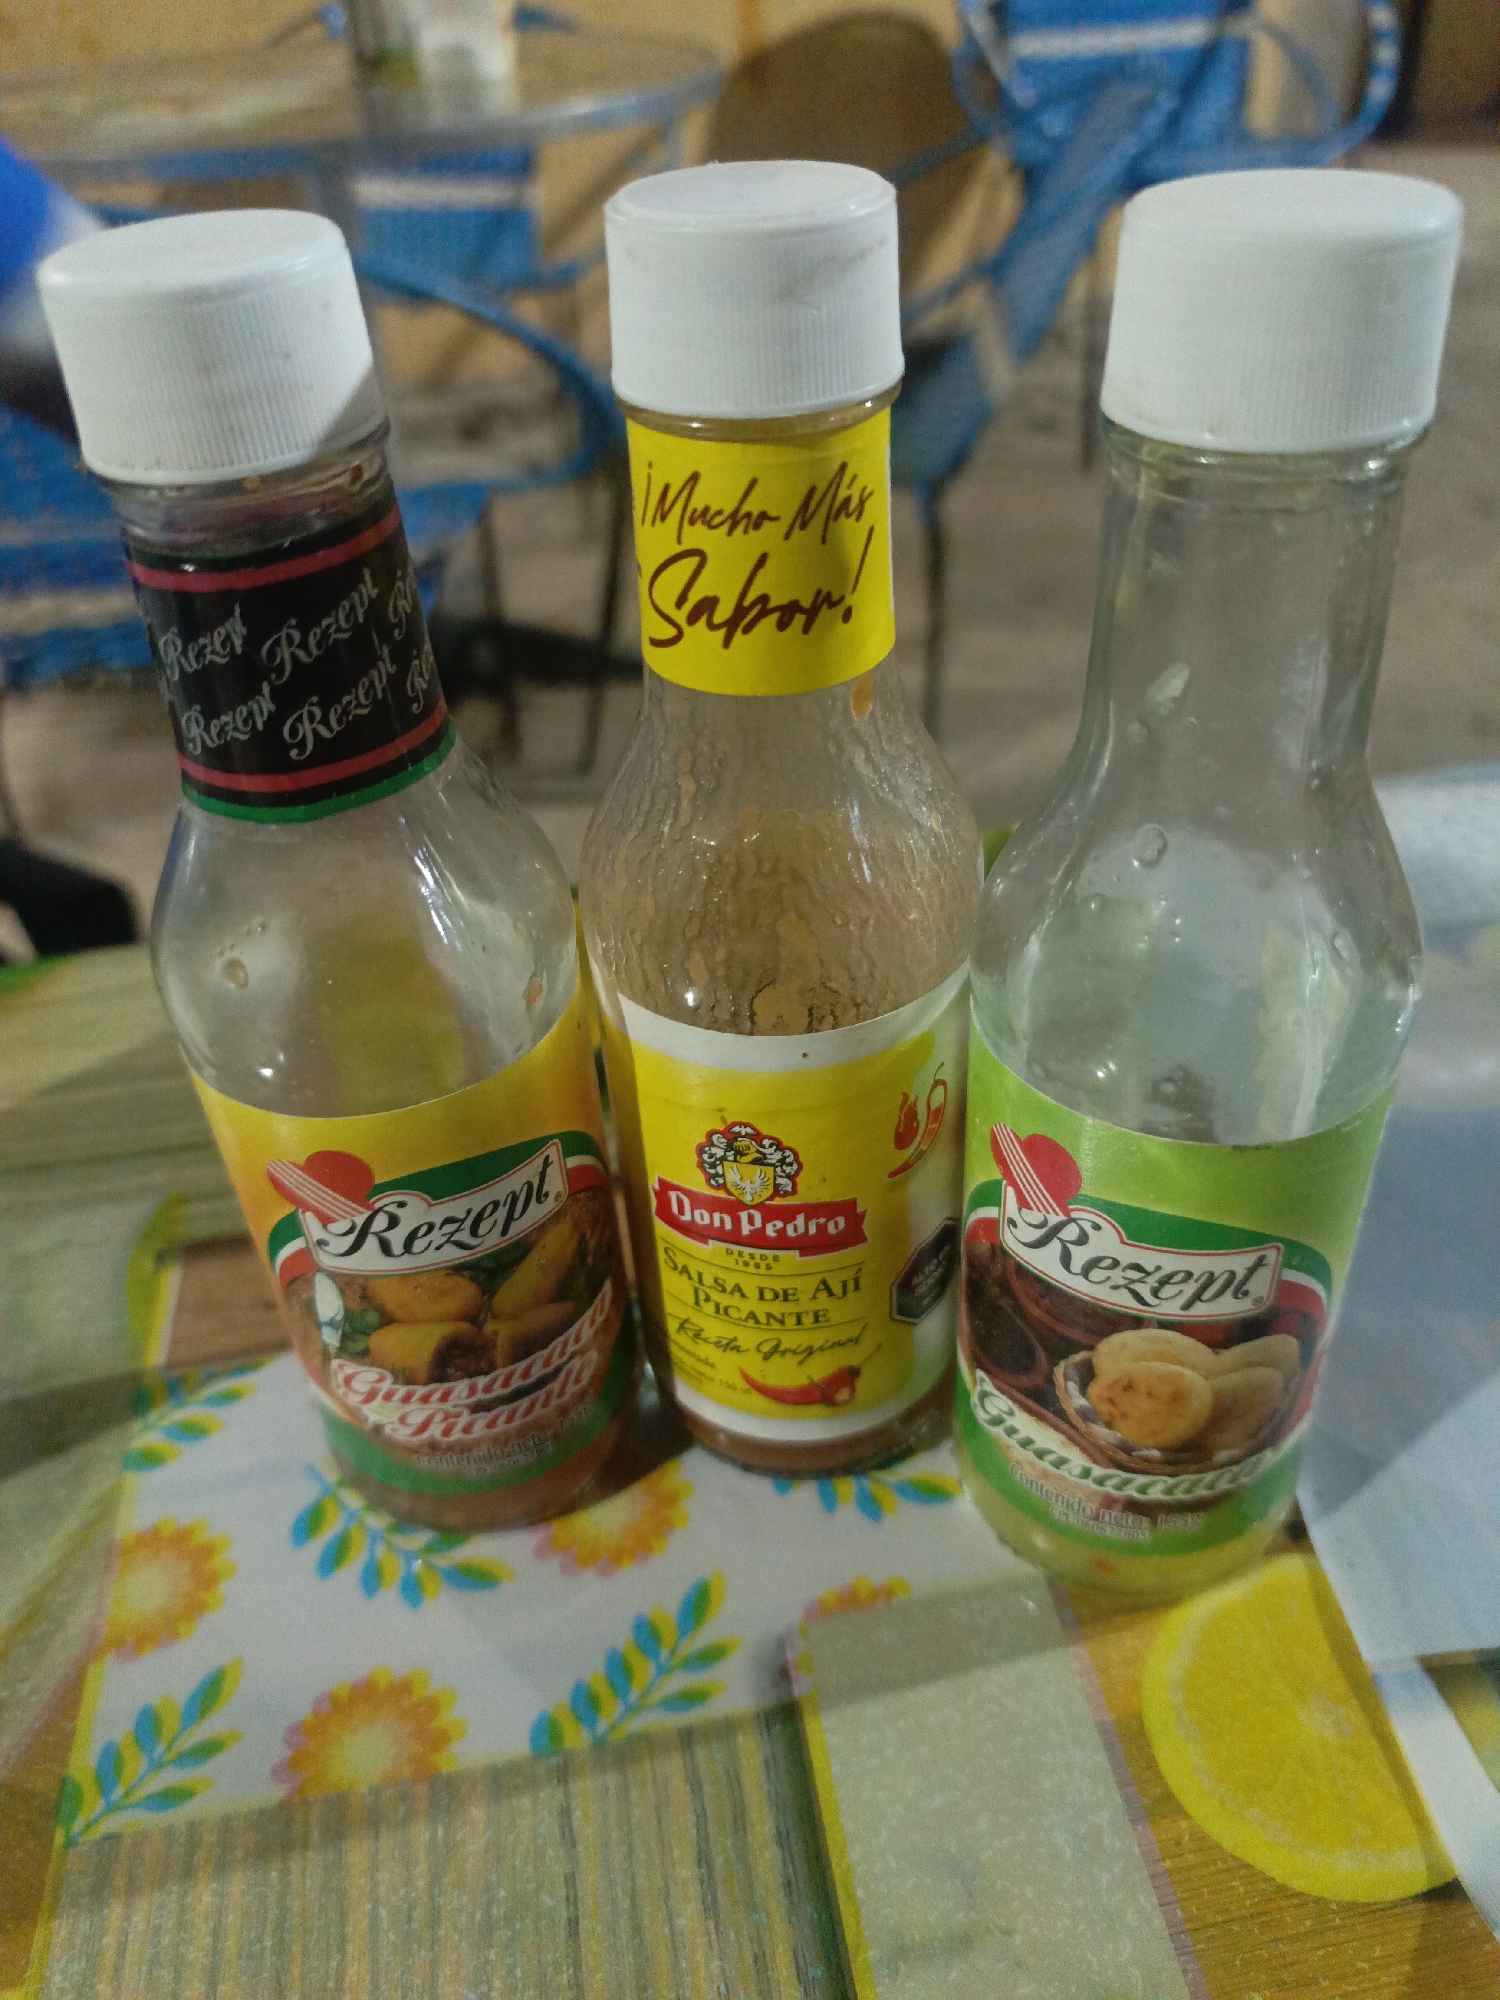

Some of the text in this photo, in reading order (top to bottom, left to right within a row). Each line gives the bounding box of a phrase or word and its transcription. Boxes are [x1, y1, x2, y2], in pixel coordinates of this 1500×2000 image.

[783, 461, 875, 546] Más
[260, 566, 379, 685] Rezept
[648, 525, 875, 650] Sabor!
[158, 602, 248, 682] Rezept
[180, 681, 277, 756] Rezept
[282, 642, 398, 760] Rezept
[315, 1152, 554, 1259] Rezept
[667, 1190, 846, 1239] Don Pedro
[663, 1246, 749, 1300] SALSA
[757, 1285, 801, 1303] DE
[725, 1247, 781, 1262] DESDE
[1006, 1206, 1269, 1312] Rezept
[691, 1283, 830, 1327] PICANTE
[1009, 1462, 1096, 1520] Contenido
